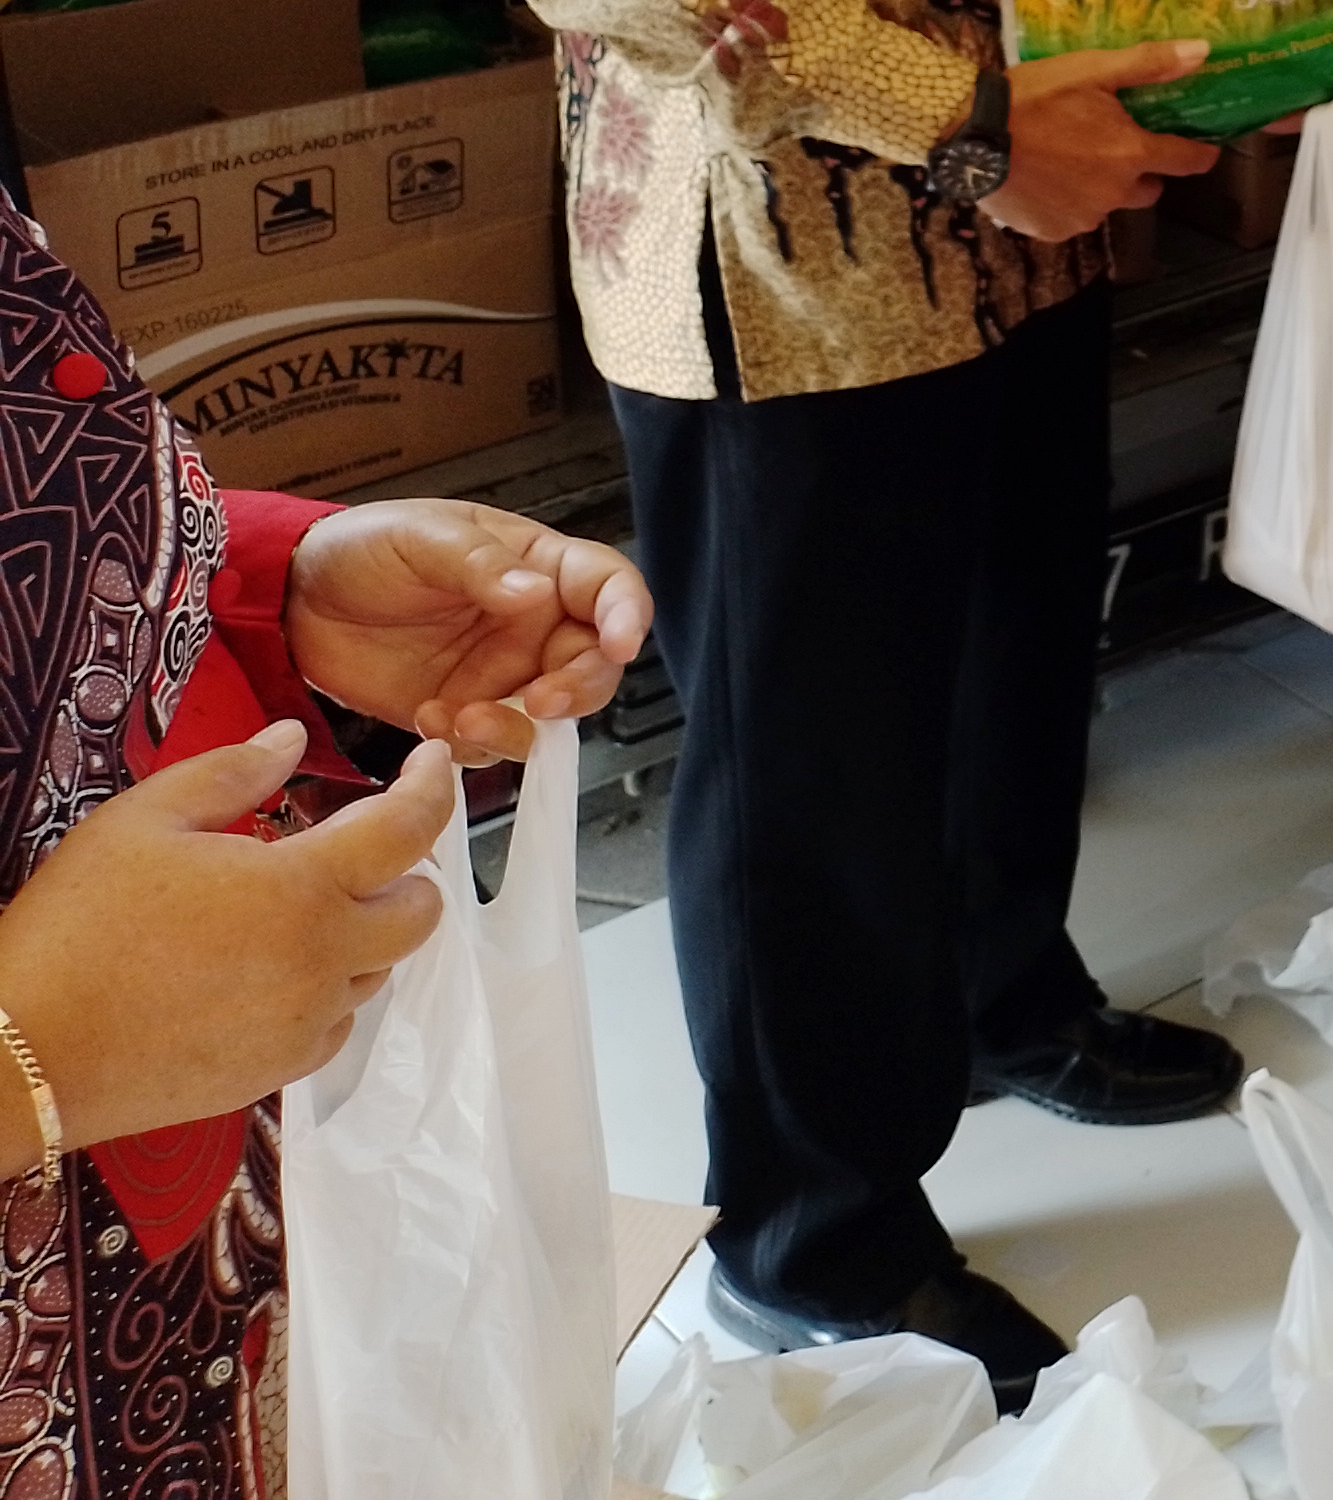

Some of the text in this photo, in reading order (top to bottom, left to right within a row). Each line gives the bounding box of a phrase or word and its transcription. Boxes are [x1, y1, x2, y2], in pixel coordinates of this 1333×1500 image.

[145, 116, 437, 190] STORE IN A COOL AND DRY PLACE
